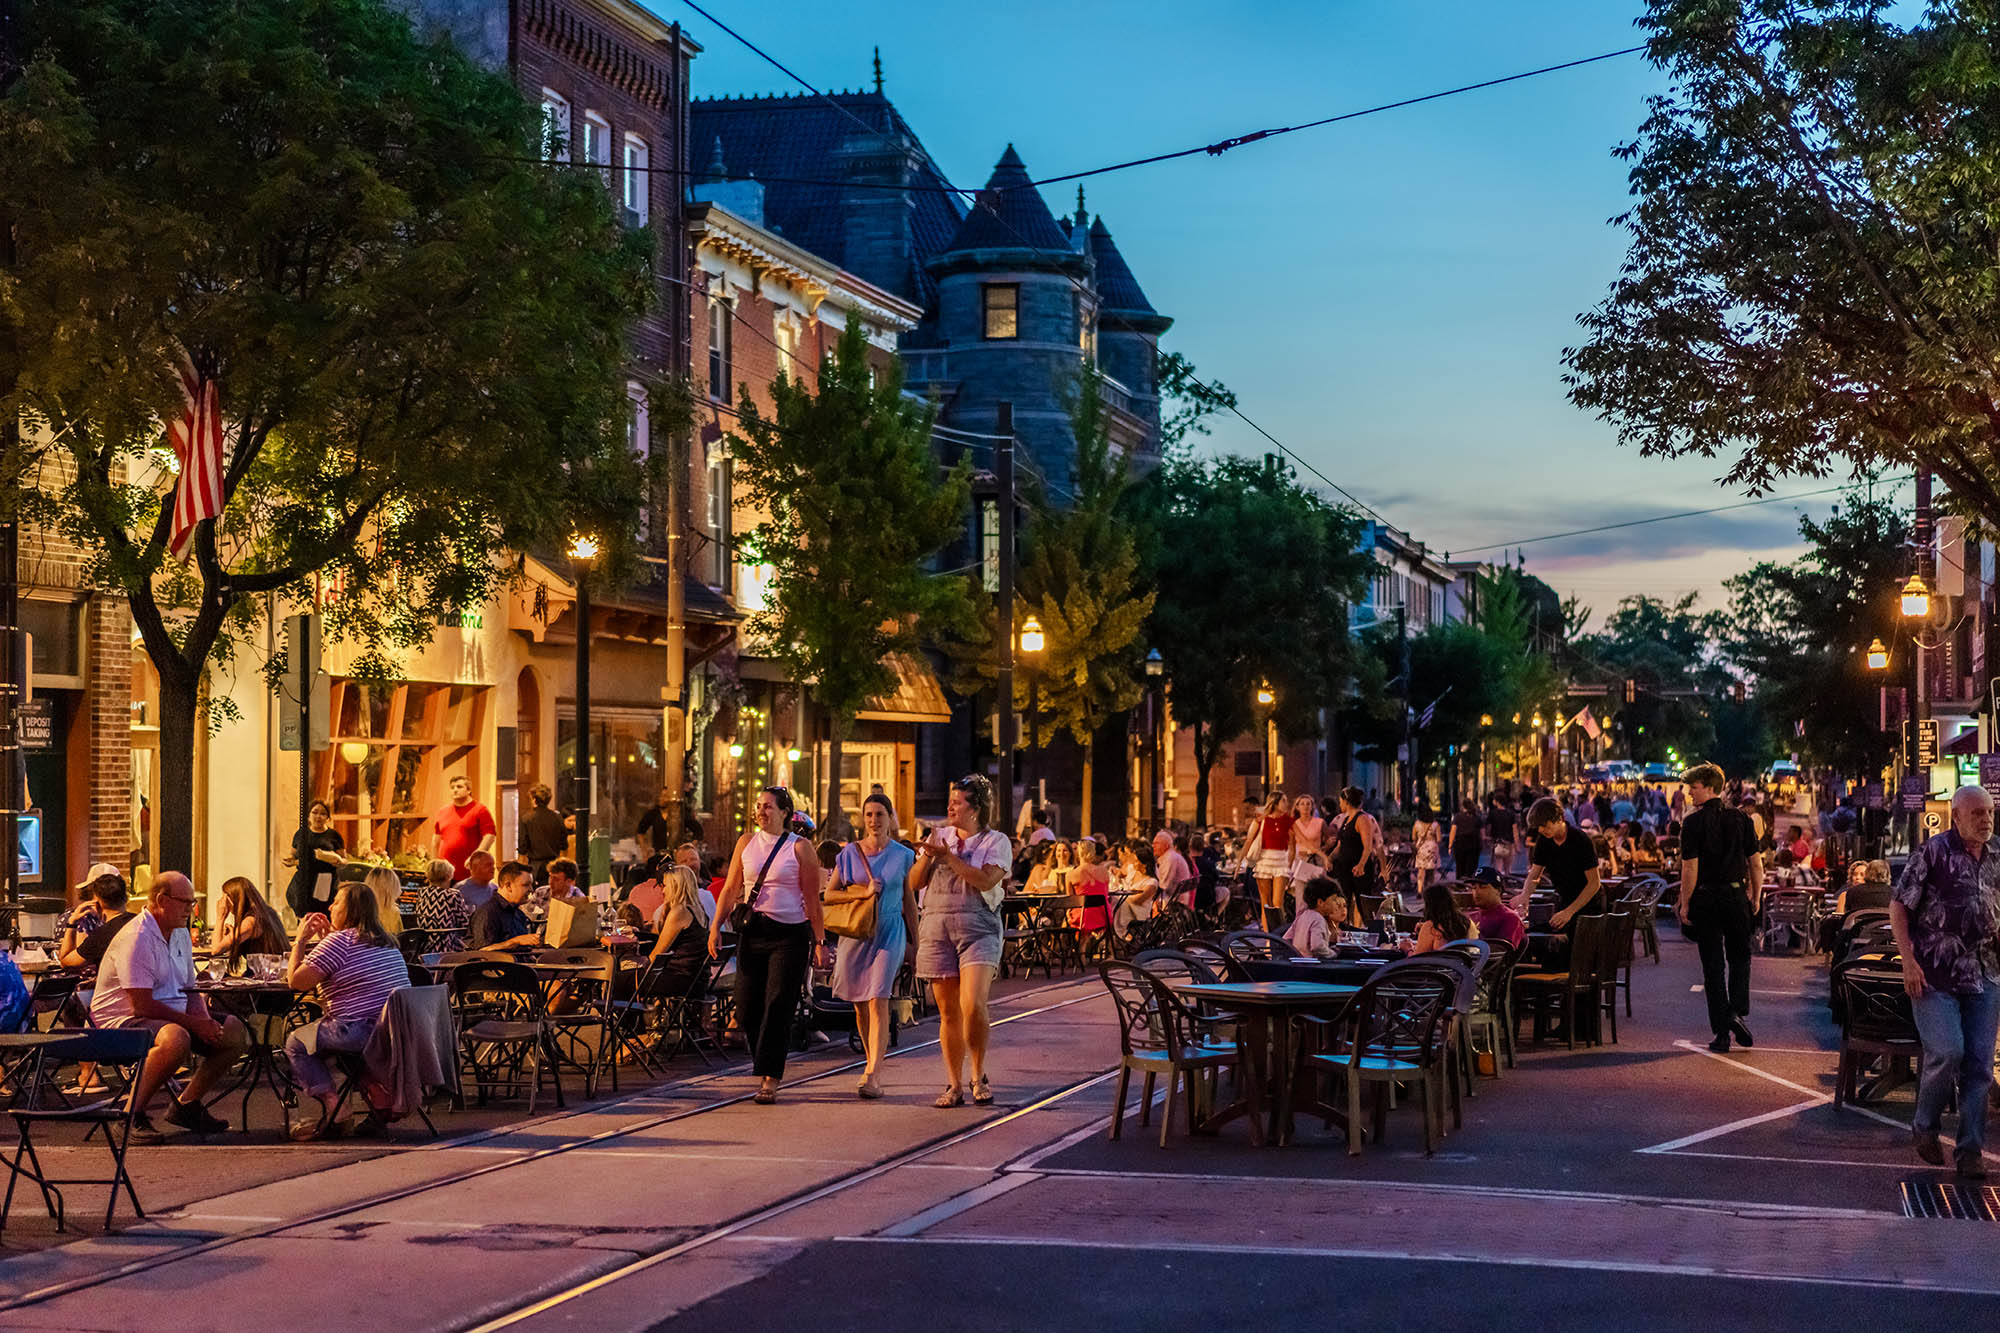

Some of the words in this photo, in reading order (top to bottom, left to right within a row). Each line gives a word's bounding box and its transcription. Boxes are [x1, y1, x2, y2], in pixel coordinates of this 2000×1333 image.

[26, 717, 51, 728] DEPOSIT
[26, 728, 51, 738] TAKING
[1929, 815, 1938, 827] P
